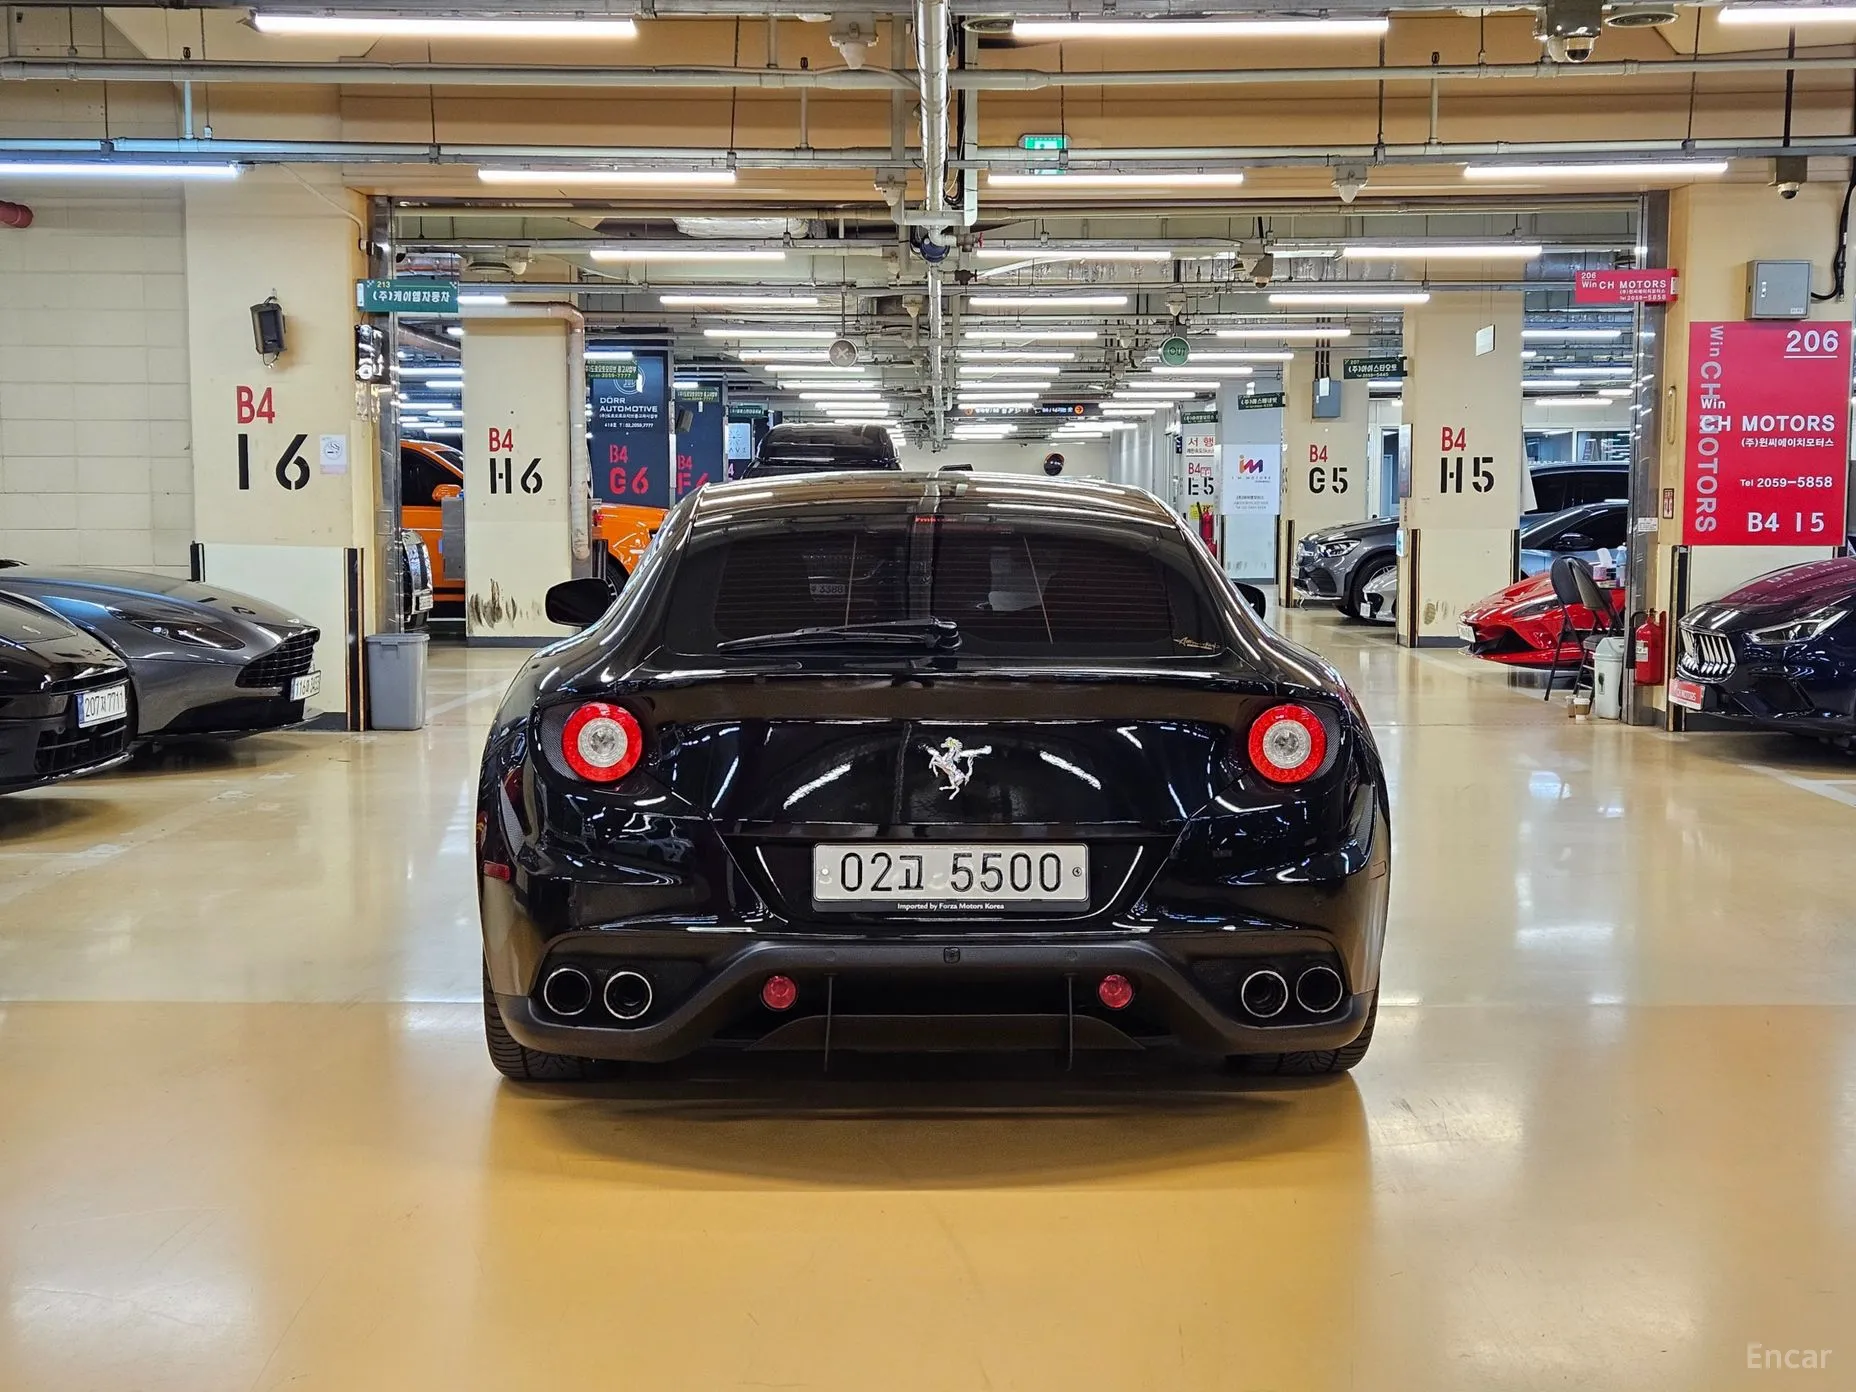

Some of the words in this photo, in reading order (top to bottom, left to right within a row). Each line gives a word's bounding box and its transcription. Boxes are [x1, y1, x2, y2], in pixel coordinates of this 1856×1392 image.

[1599, 281, 1615, 289] CH
[1620, 280, 1666, 288] MOTORS
[1709, 325, 1724, 357] Win
[1786, 330, 1839, 352] 206
[1700, 361, 1722, 400] CH
[236, 385, 276, 424] B4
[1701, 399, 1725, 409] Win
[1701, 415, 1731, 431] CH
[1742, 415, 1835, 432] MOTORS
[489, 427, 513, 452] B4
[1442, 427, 1466, 451] B4
[276, 434, 310, 491] 6
[609, 445, 628, 463] B4
[677, 454, 692, 470] B4
[1309, 445, 1328, 462] B4
[490, 458, 512, 494] H
[520, 458, 543, 494] 6
[632, 466, 649, 495] 6
[1188, 462, 1201, 475] B4
[1332, 467, 1348, 494] 5
[1440, 457, 1463, 493] H
[1472, 457, 1495, 493] 5
[1695, 415, 1720, 532] MOTORS
[1740, 479, 1754, 487] Tel
[1757, 476, 1833, 488] 2059-5858
[1747, 512, 1779, 532] B4
[1810, 512, 1825, 532] 5
[840, 852, 924, 892] 02고
[950, 853, 1062, 892] 5500
[897, 902, 928, 911] Imported
[929, 902, 937, 911] by
[939, 902, 957, 910] Forza
[959, 902, 984, 910] Motors
[985, 902, 1004, 910] Korea
